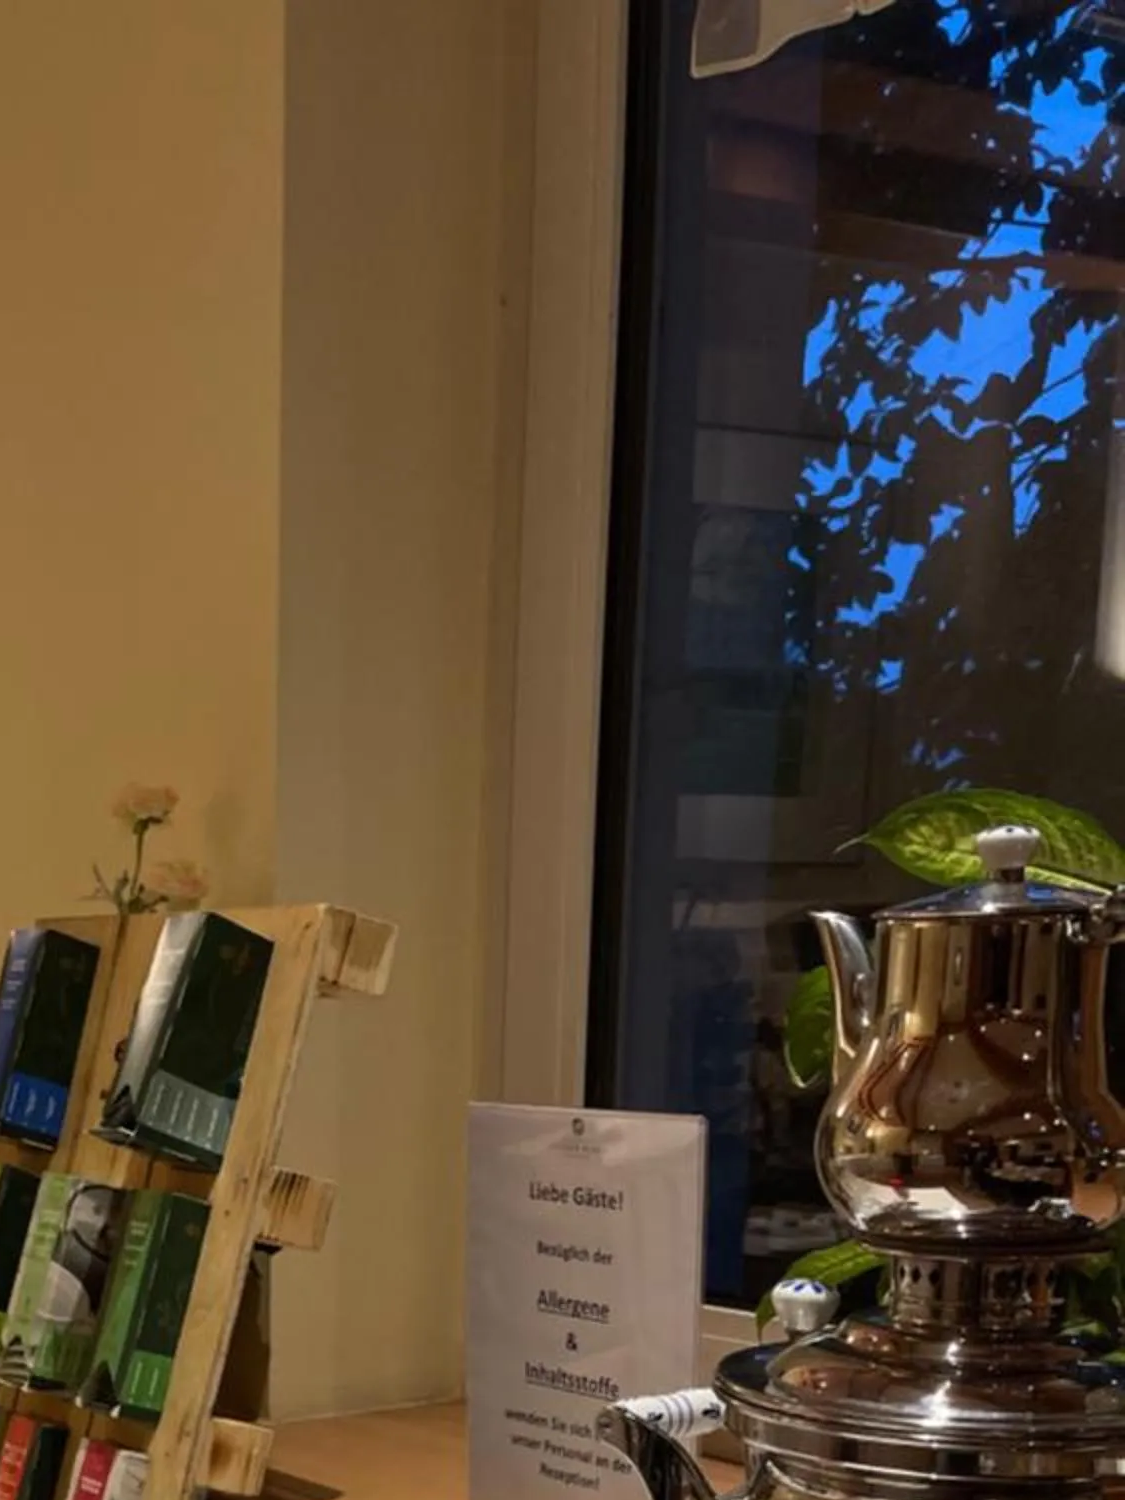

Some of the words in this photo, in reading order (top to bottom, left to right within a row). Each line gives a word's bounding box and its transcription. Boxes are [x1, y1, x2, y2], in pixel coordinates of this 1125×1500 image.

[528, 1180, 570, 1205] Liebe
[572, 1186, 625, 1212] Gäste!
[537, 1240, 590, 1263] Bezüglich
[592, 1246, 614, 1266] der
[536, 1288, 611, 1320] Allergene
[565, 1332, 578, 1351] &
[525, 1360, 620, 1398] Inhaltsstoffe
[550, 1416, 568, 1434] Sie
[569, 1422, 593, 1439] sich
[510, 1434, 543, 1450] unser
[543, 1439, 594, 1464] Personal
[594, 1455, 610, 1469] an
[611, 1458, 634, 1476] der
